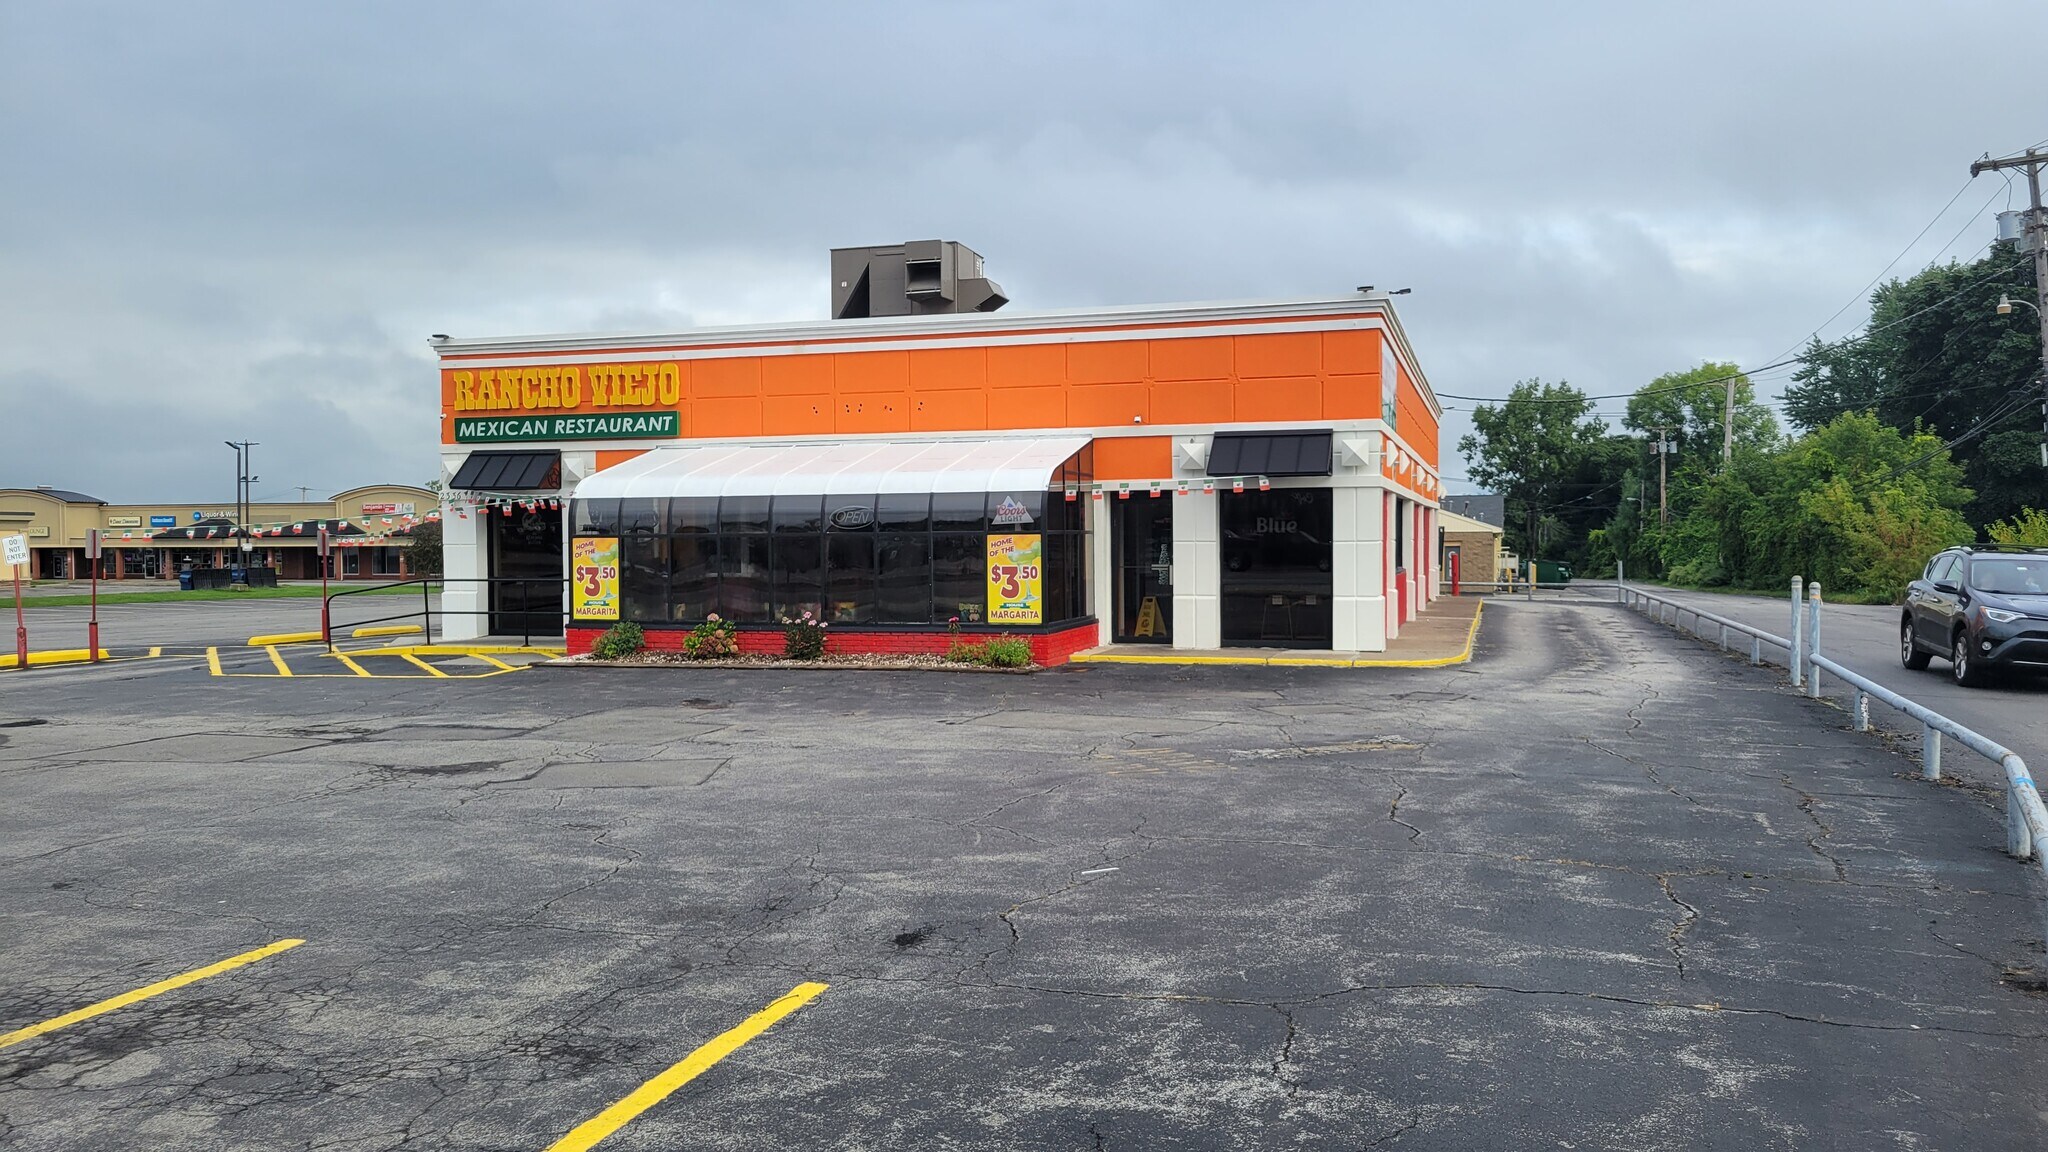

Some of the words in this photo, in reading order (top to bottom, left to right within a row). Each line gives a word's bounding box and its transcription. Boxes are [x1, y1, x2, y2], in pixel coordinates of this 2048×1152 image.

[453, 367, 581, 411] RANCHO
[587, 362, 681, 408] VIEJO
[459, 419, 548, 438] MEXICAN
[554, 415, 673, 434] RESTAURANT
[997, 504, 1026, 516] Coors
[200, 511, 219, 519] Liquor
[836, 510, 870, 524] OPEN
[1000, 515, 1023, 523] LIGHT
[1256, 517, 1298, 534] Blue
[8, 538, 18, 546] DO
[575, 541, 594, 550] HOME
[990, 537, 1013, 548] HOME
[8, 545, 21, 553] NOT
[989, 549, 999, 557] OF
[1001, 545, 1015, 555] THE
[6, 552, 27, 561] ENTER
[576, 608, 617, 616] MARGARITA
[990, 610, 1039, 619] MARGARITA
